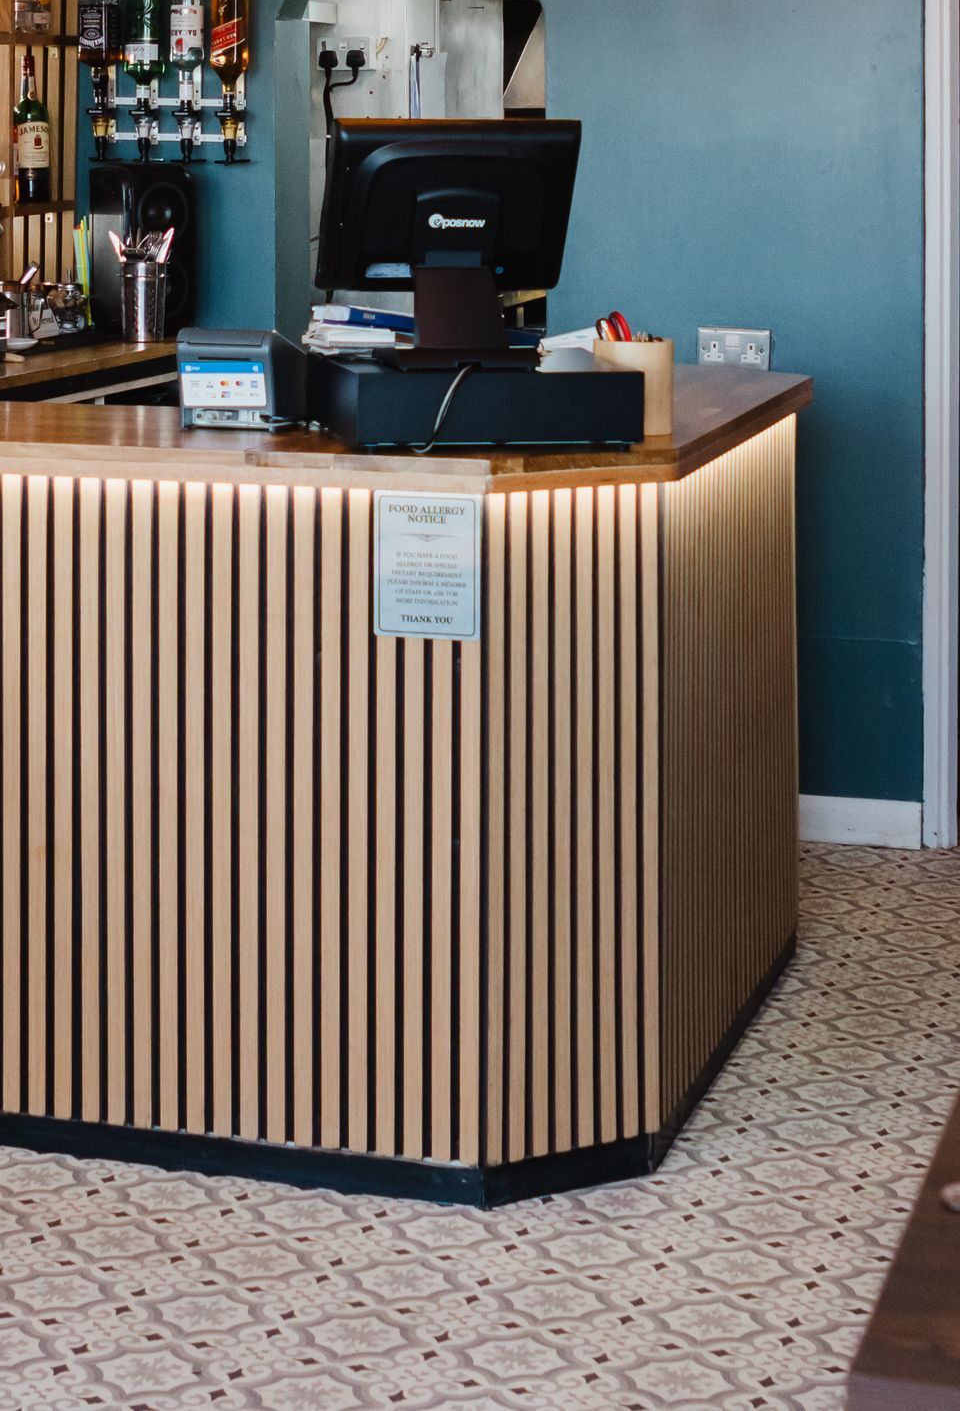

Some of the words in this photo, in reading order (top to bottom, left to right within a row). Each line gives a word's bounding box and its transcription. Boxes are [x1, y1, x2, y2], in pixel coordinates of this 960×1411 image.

[170, 29, 198, 37] BAARD
[20, 125, 48, 136] JAMESO
[389, 504, 418, 514] FOOD
[421, 505, 466, 516] ALLERGY
[407, 514, 447, 524] NOTICE
[400, 614, 433, 624] THANK
[434, 616, 453, 625] YOU
